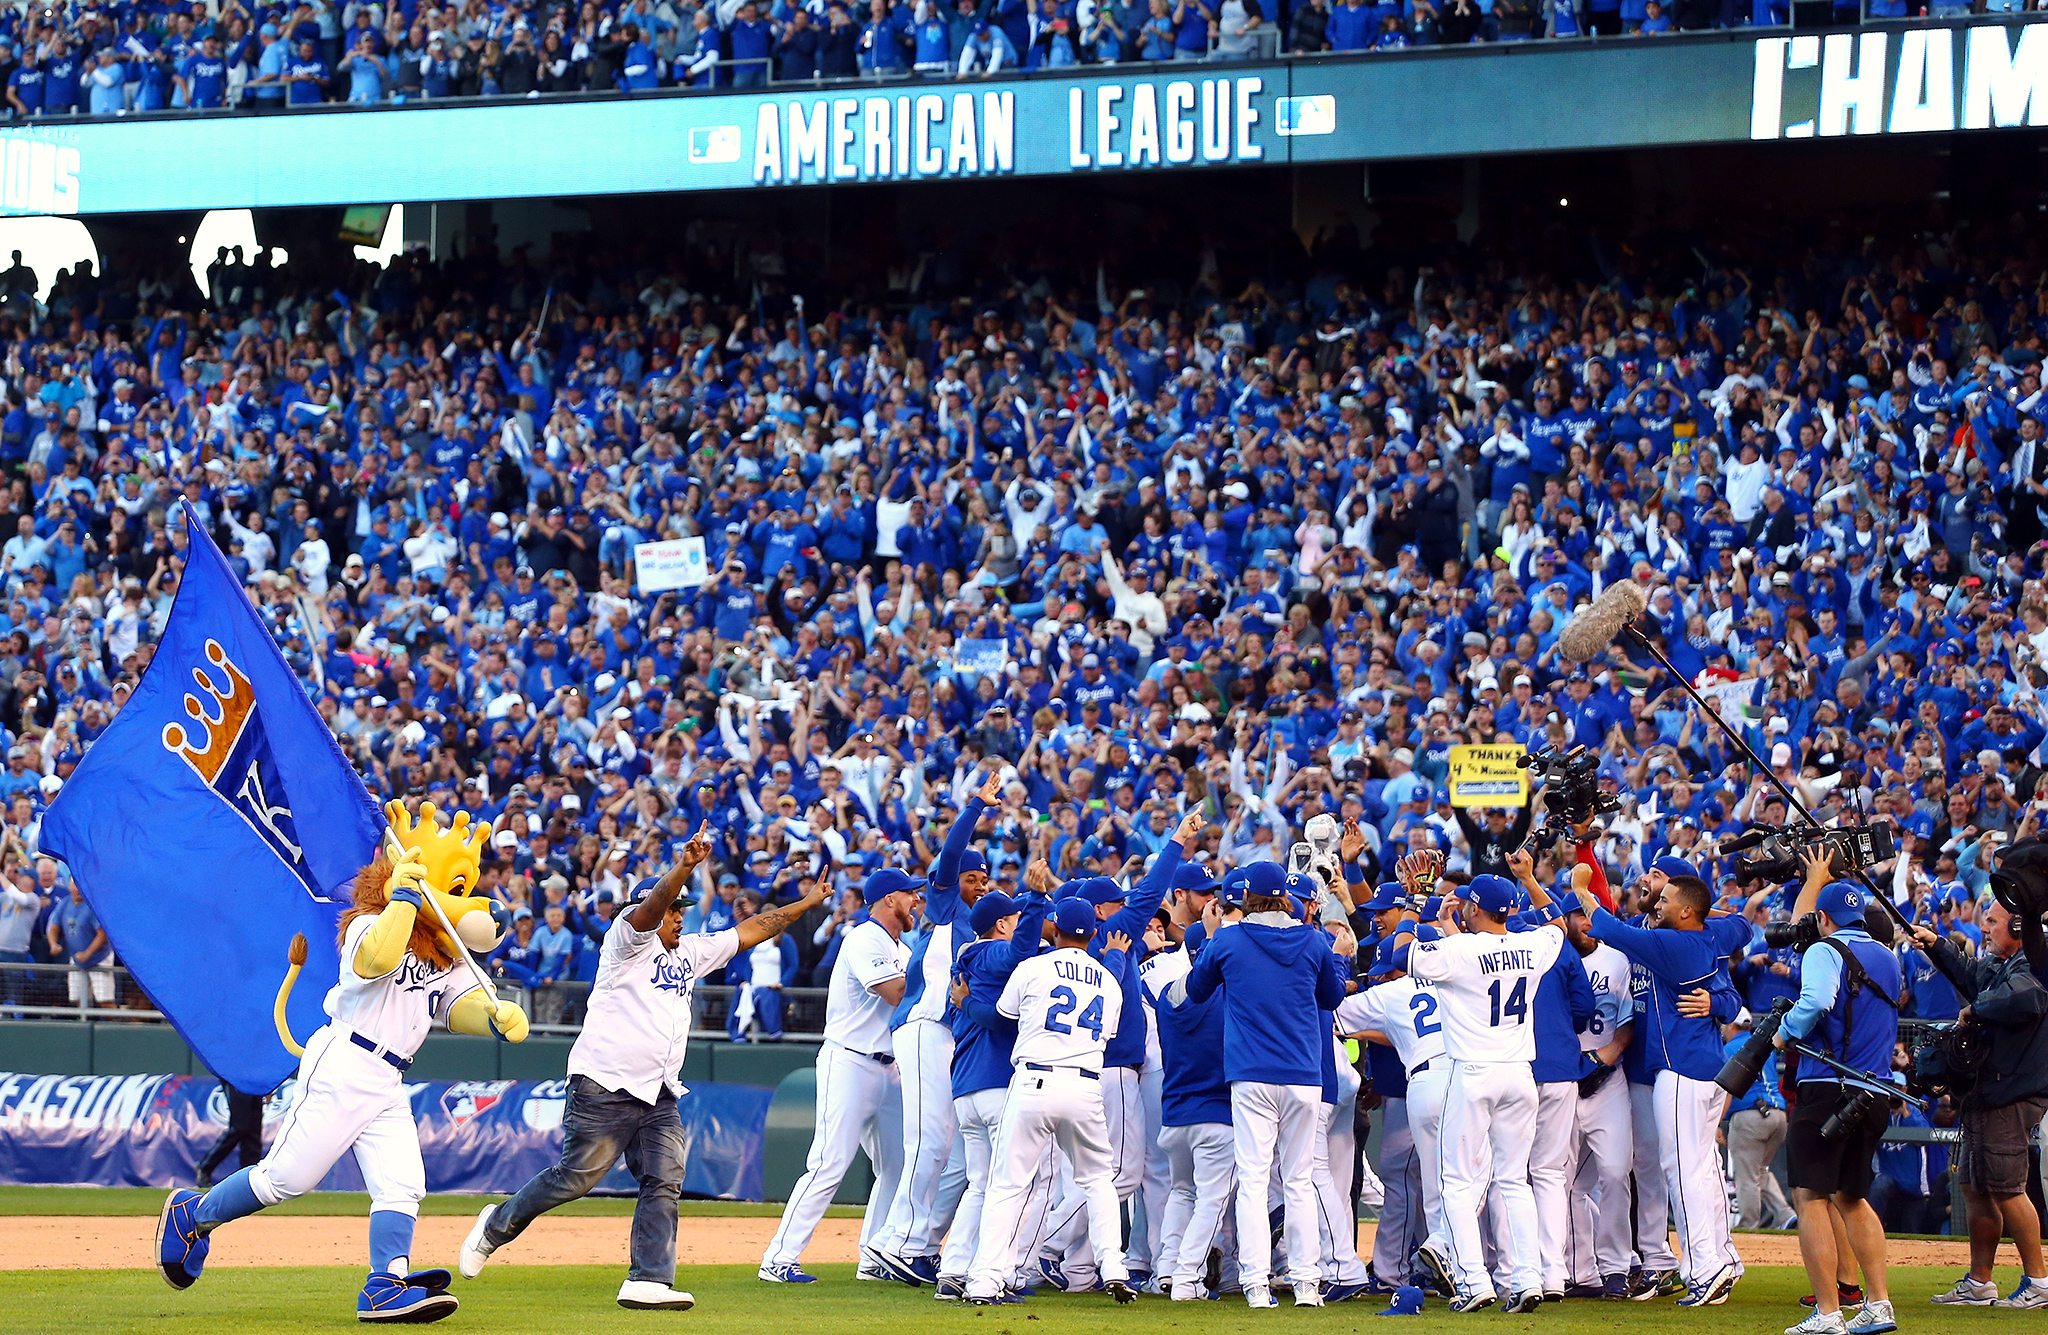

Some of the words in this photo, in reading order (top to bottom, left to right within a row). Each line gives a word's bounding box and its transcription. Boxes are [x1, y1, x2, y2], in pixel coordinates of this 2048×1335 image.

[753, 90, 1015, 182] AMERICAN
[1069, 77, 1263, 168] LEAGUE
[1453, 764, 1462, 776] 4
[1478, 949, 1535, 975] INFANTE
[1044, 984, 1104, 1042] 24
[1487, 976, 1528, 1028] 14
